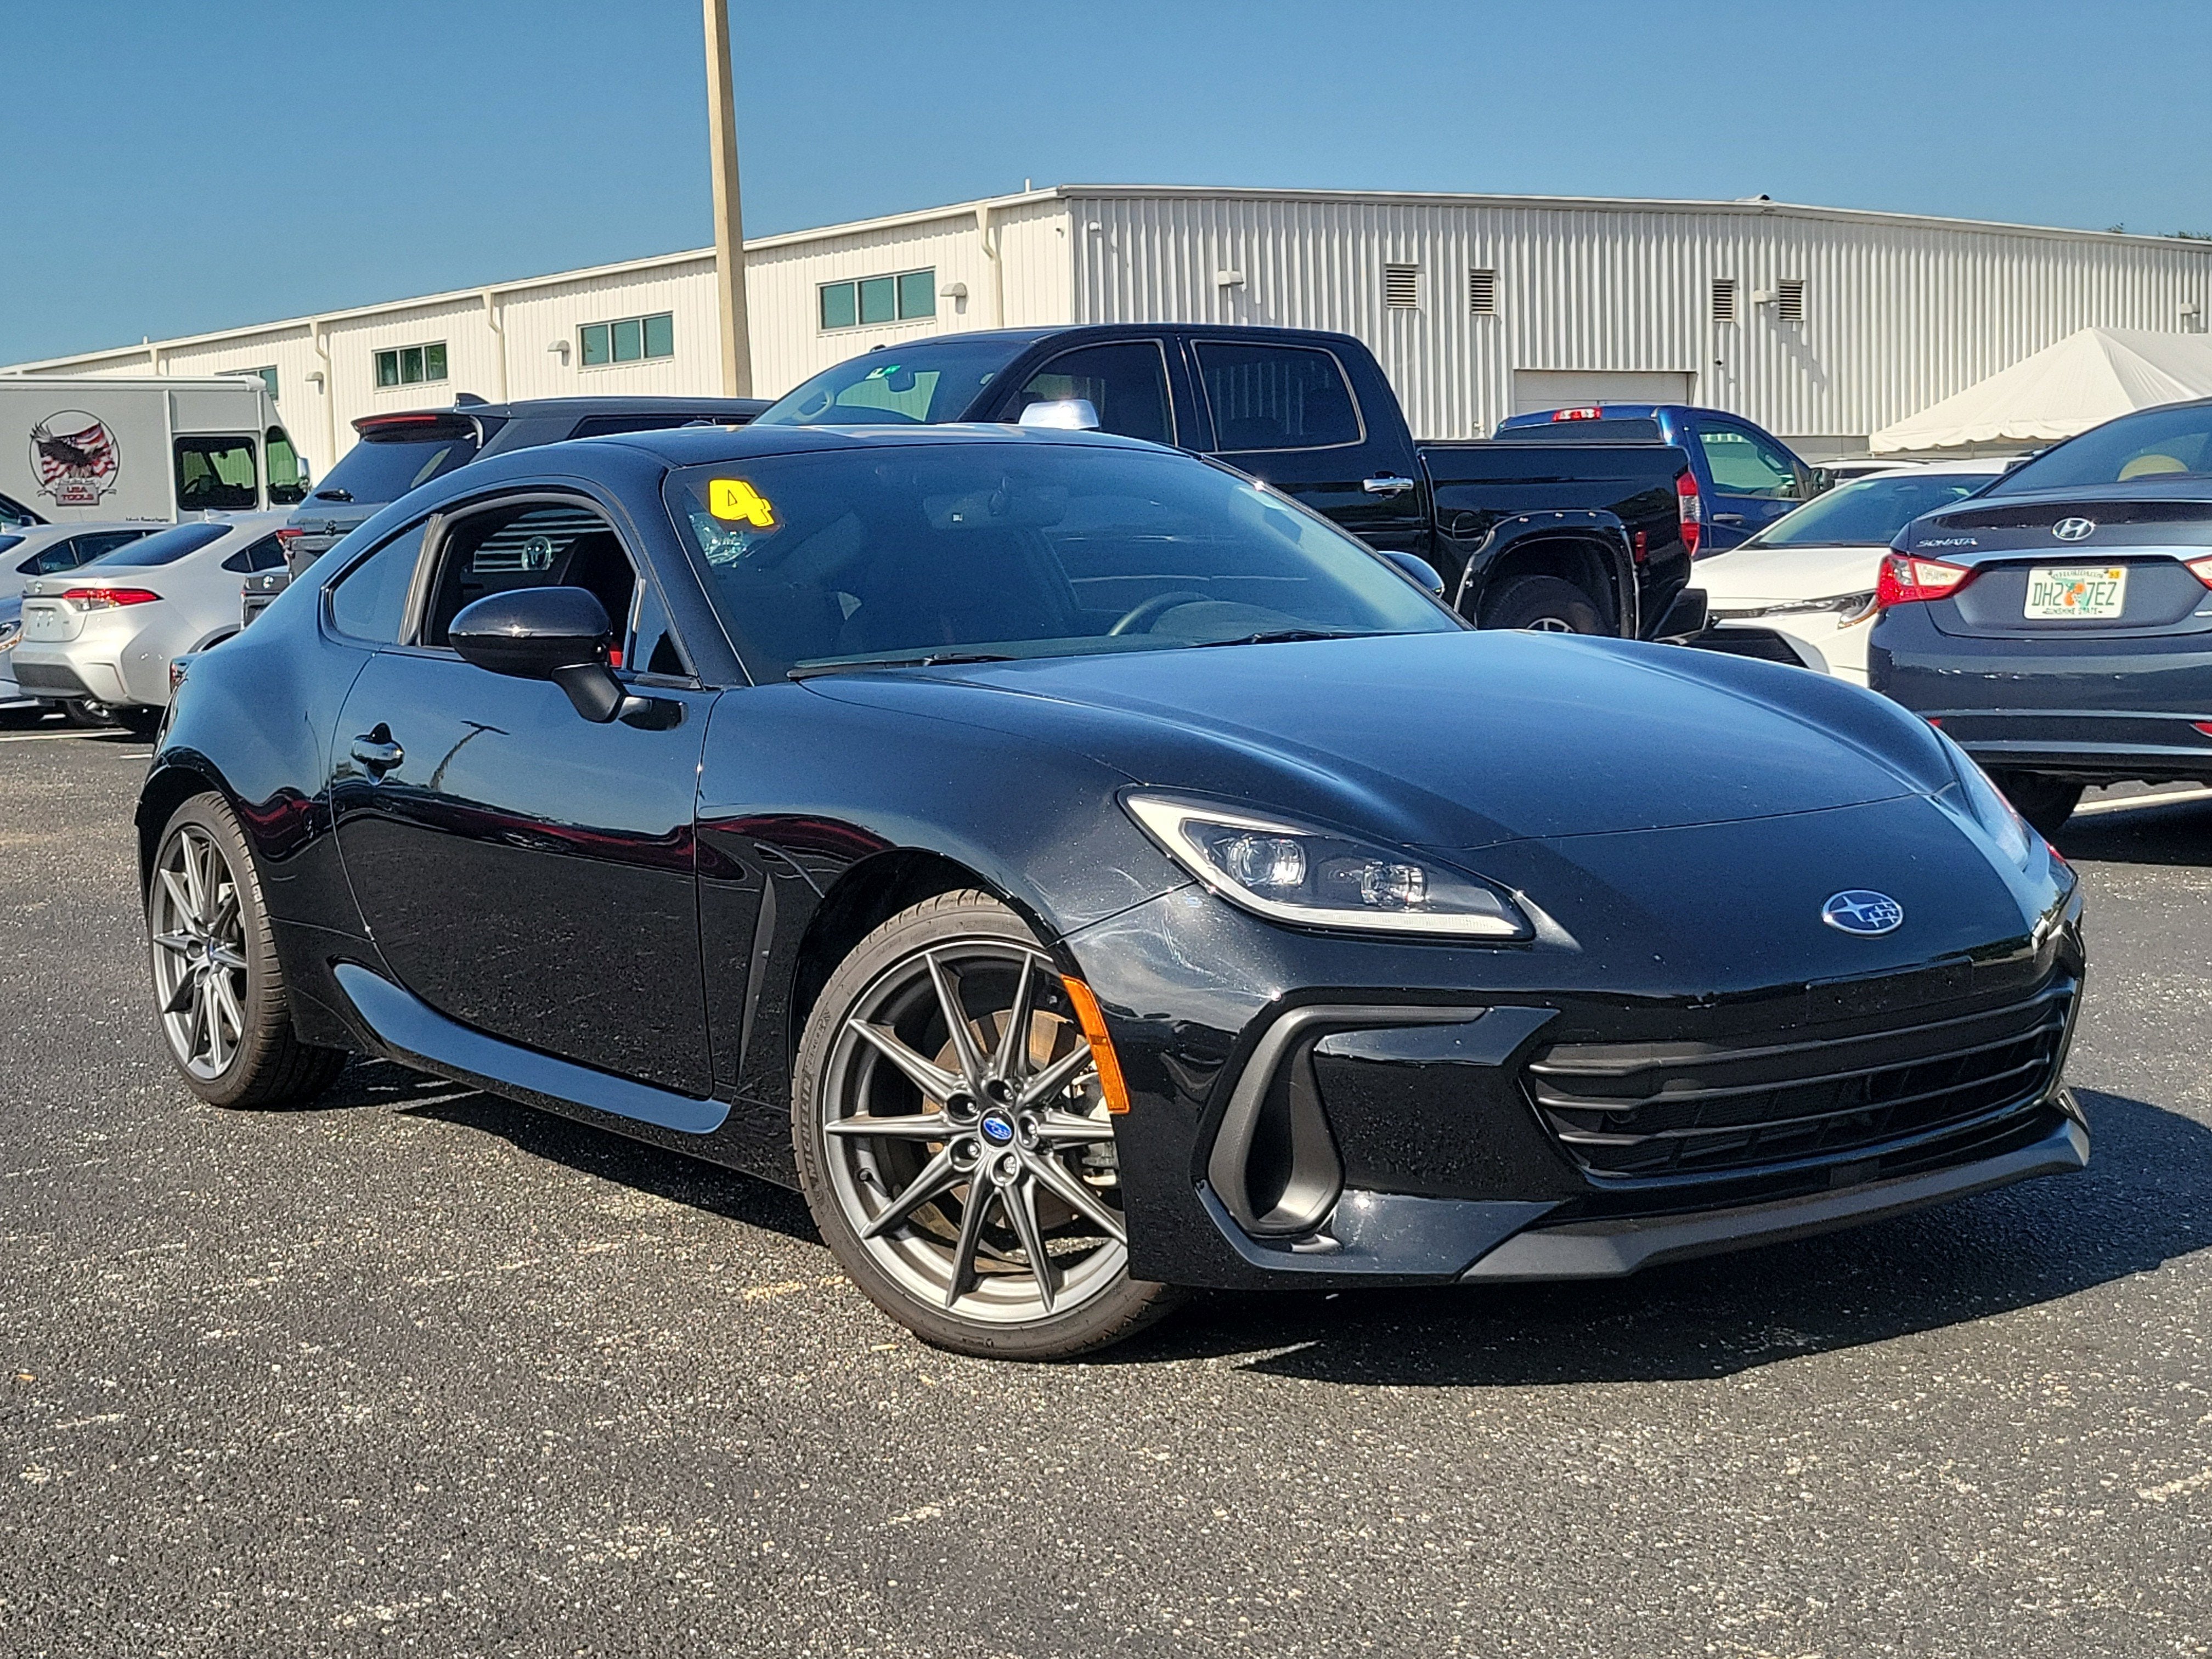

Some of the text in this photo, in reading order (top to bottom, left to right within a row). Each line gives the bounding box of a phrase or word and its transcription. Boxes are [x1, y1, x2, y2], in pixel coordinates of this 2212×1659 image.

[709, 479, 775, 527] 4
[1916, 537, 1978, 547] SONATA
[2032, 582, 2117, 606] DH2 7EZ
[801, 1076, 817, 1179] MICHELIN
